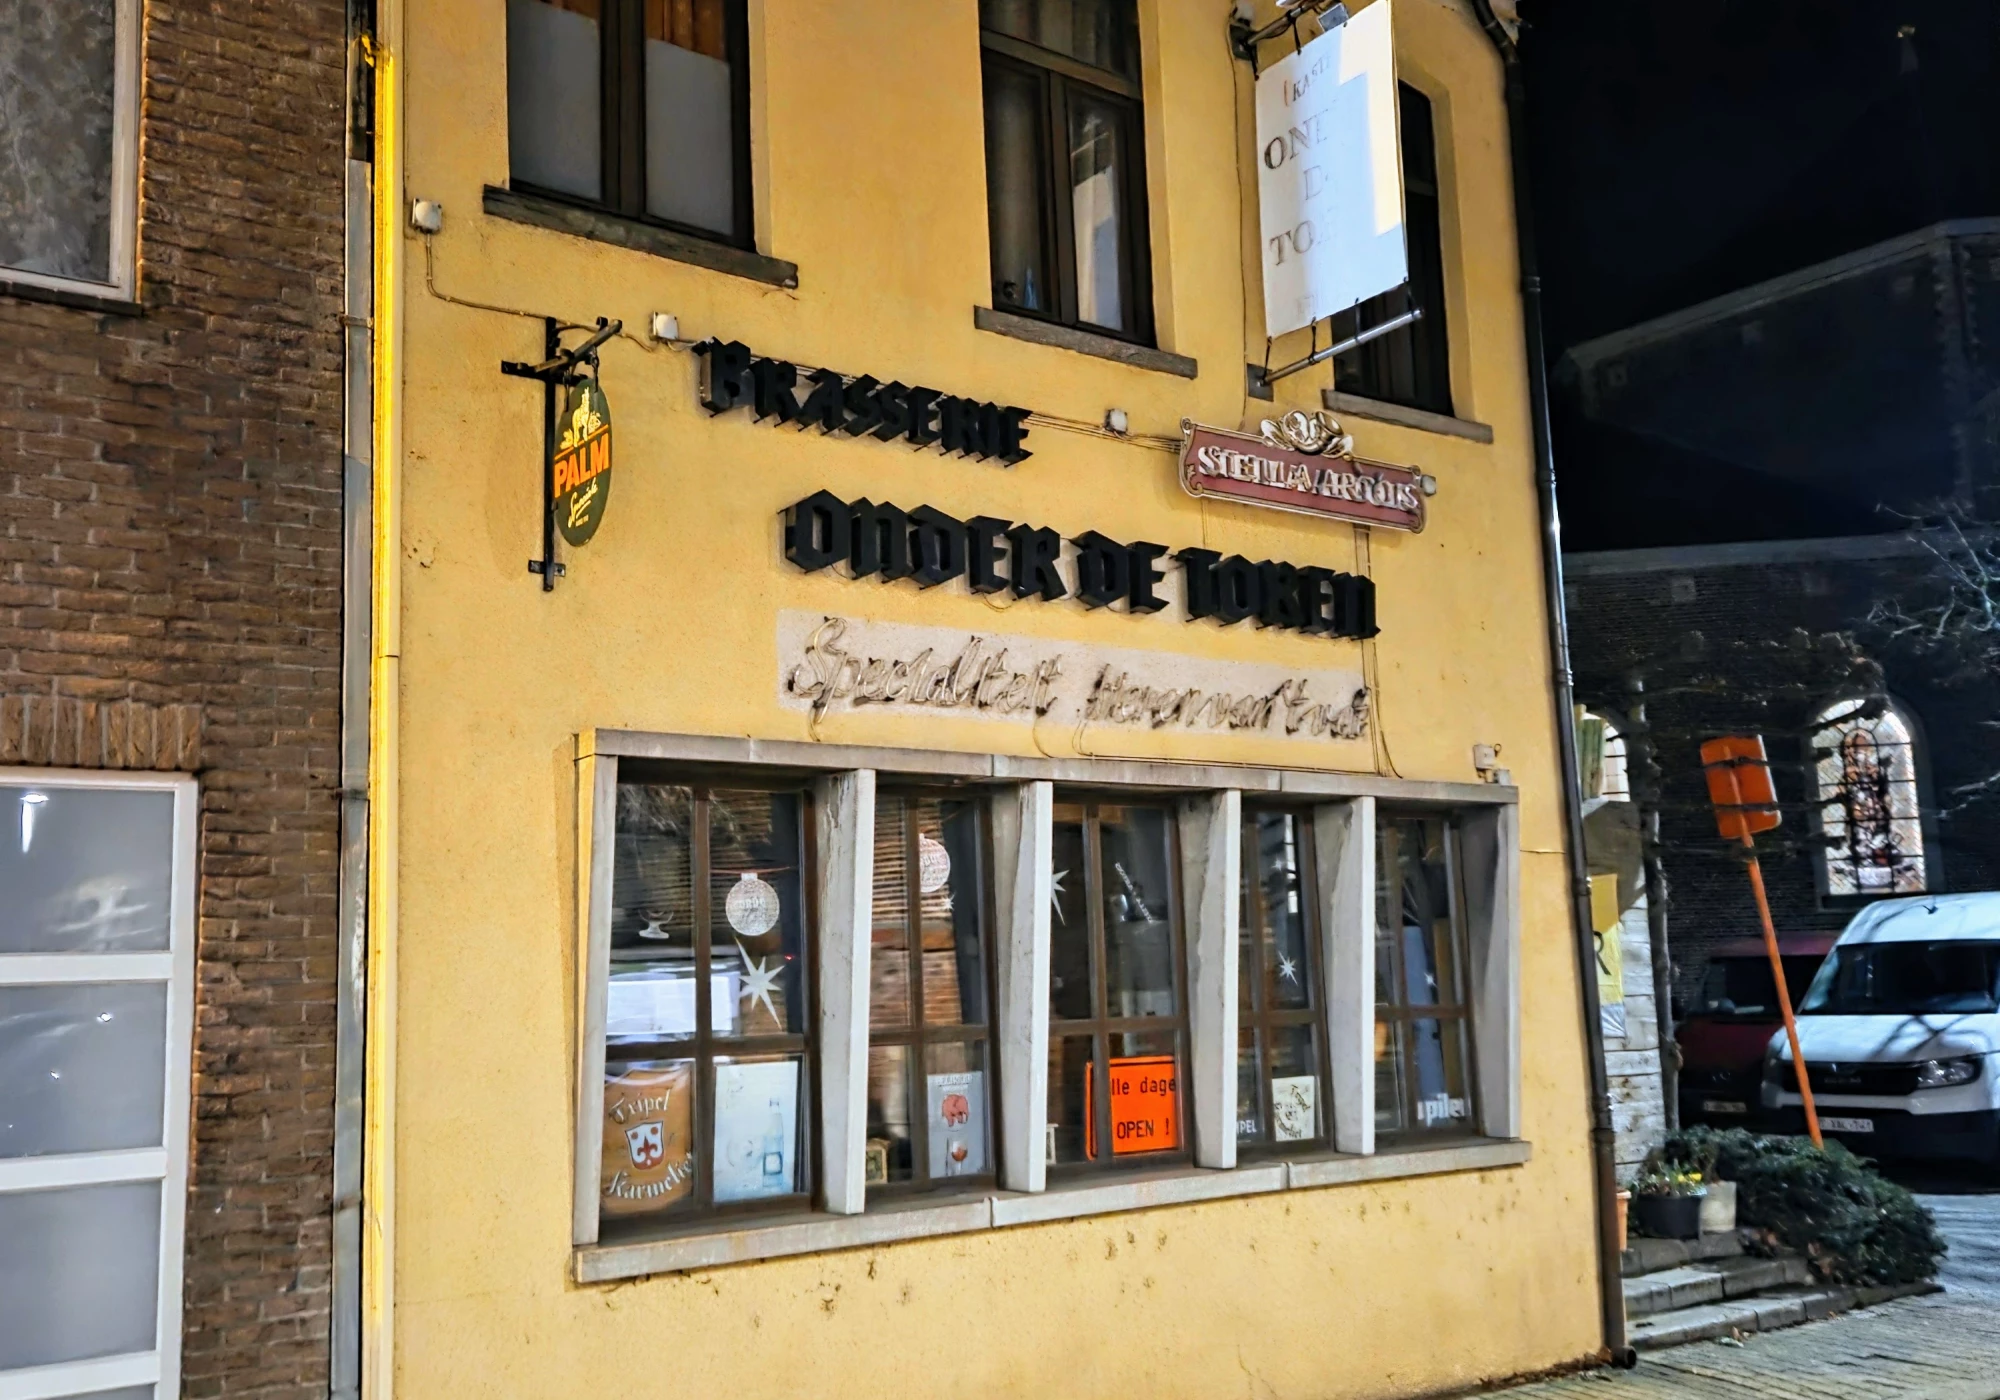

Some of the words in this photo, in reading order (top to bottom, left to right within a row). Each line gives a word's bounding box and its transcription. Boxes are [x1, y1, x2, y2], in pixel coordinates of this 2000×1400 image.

[1269, 218, 1330, 267] TO
[692, 337, 1034, 466] BRASSERIE
[553, 432, 610, 499] PALM
[1197, 445, 1312, 493] STELLA
[1311, 468, 1419, 512] ARTOIS
[779, 489, 1068, 601] ONDER
[1068, 530, 1170, 615] DE
[1174, 546, 1382, 640] TOREN
[609, 1088, 671, 1124] Tripel
[1111, 1078, 1130, 1095] lle
[1139, 1076, 1176, 1096] dage
[1116, 1119, 1154, 1139] OPEN
